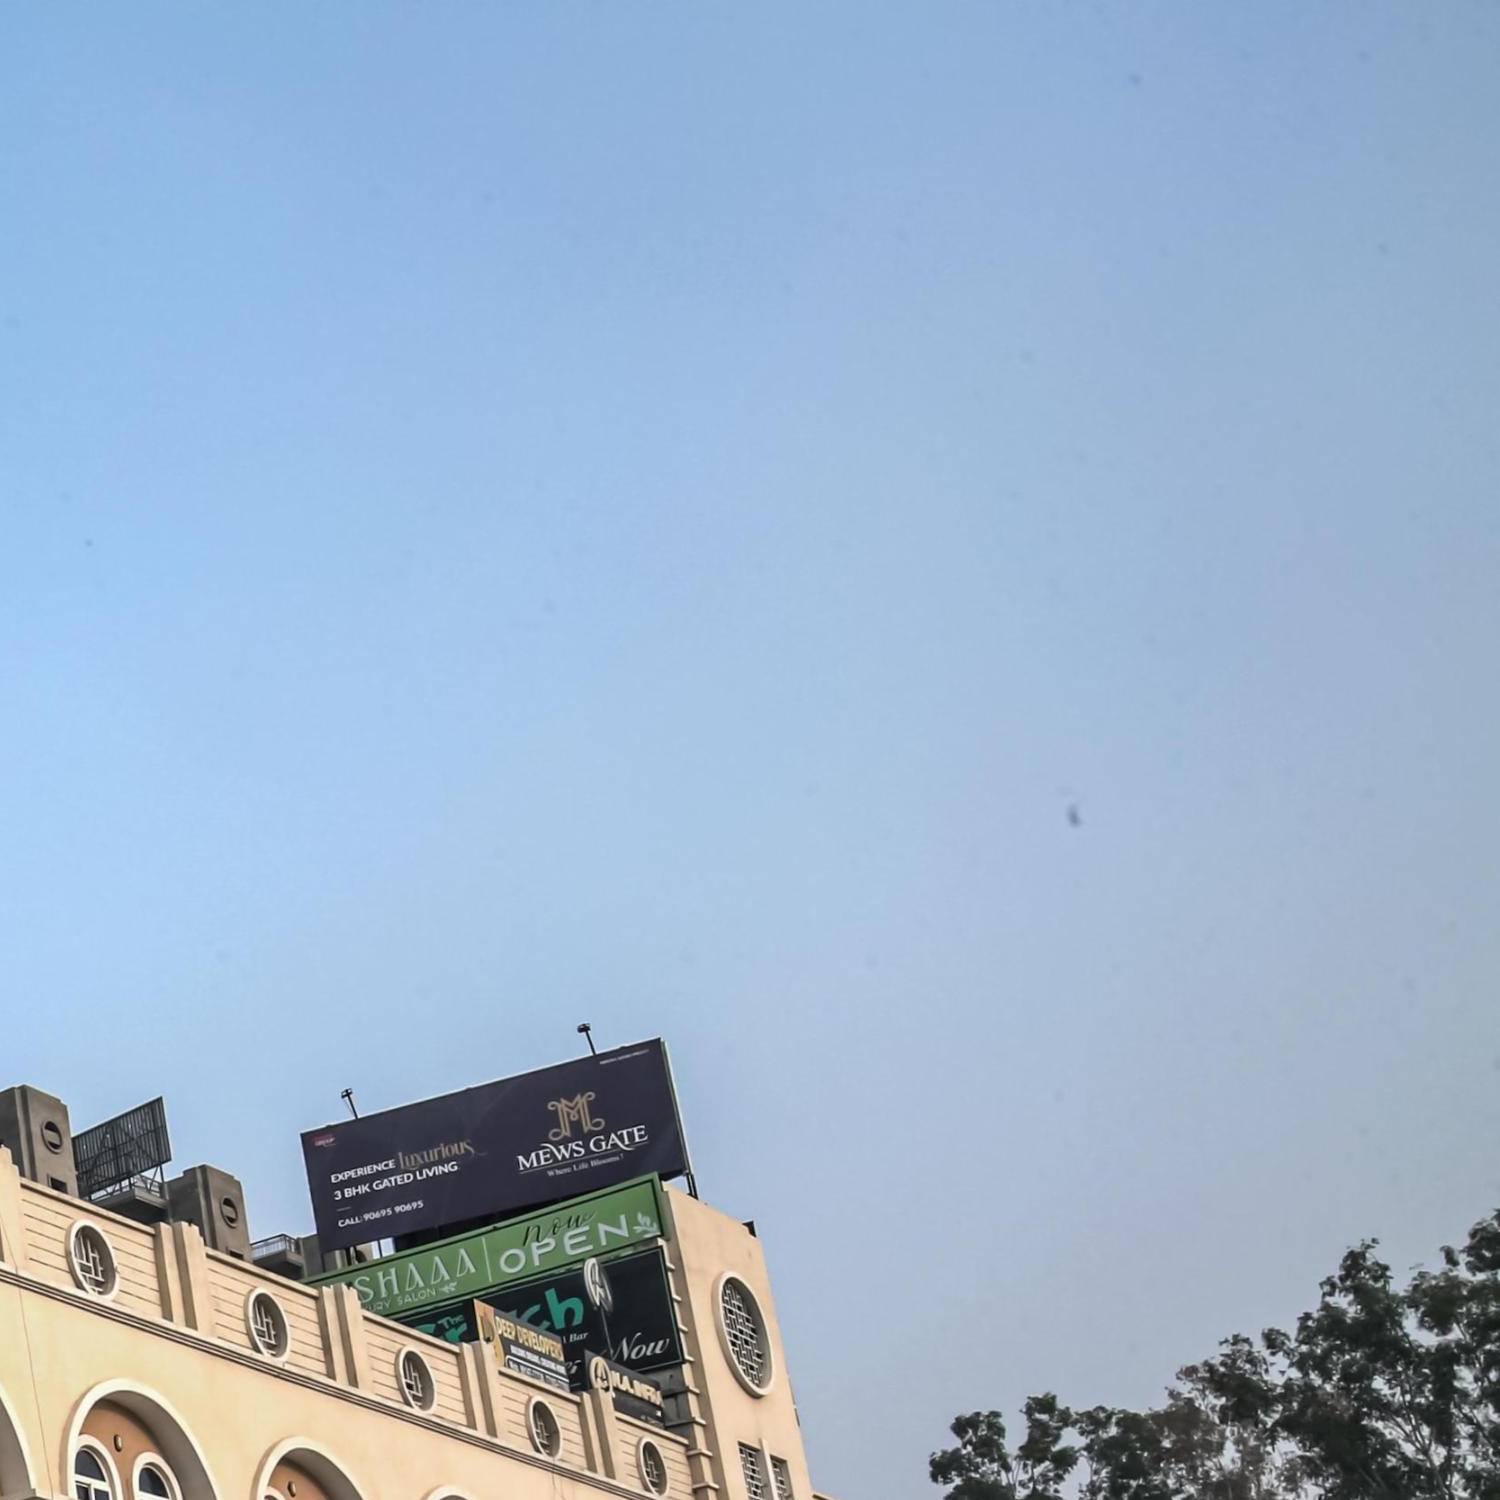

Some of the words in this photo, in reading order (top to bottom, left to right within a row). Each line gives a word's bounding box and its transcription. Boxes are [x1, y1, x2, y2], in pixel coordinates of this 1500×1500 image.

[330, 1158, 397, 1184] EXPERIENCE
[398, 1138, 482, 1171] luxurious
[516, 1140, 586, 1171] MEWS
[589, 1124, 649, 1152] GATE
[333, 1190, 343, 1201] 3
[344, 1184, 372, 1200] BHK
[372, 1171, 414, 1192] GATED
[416, 1160, 459, 1182] LIVING
[393, 1200, 425, 1214] 90695
[499, 1214, 630, 1275] OPEN
[522, 1209, 597, 1247] now
[609, 1332, 670, 1362] Now
